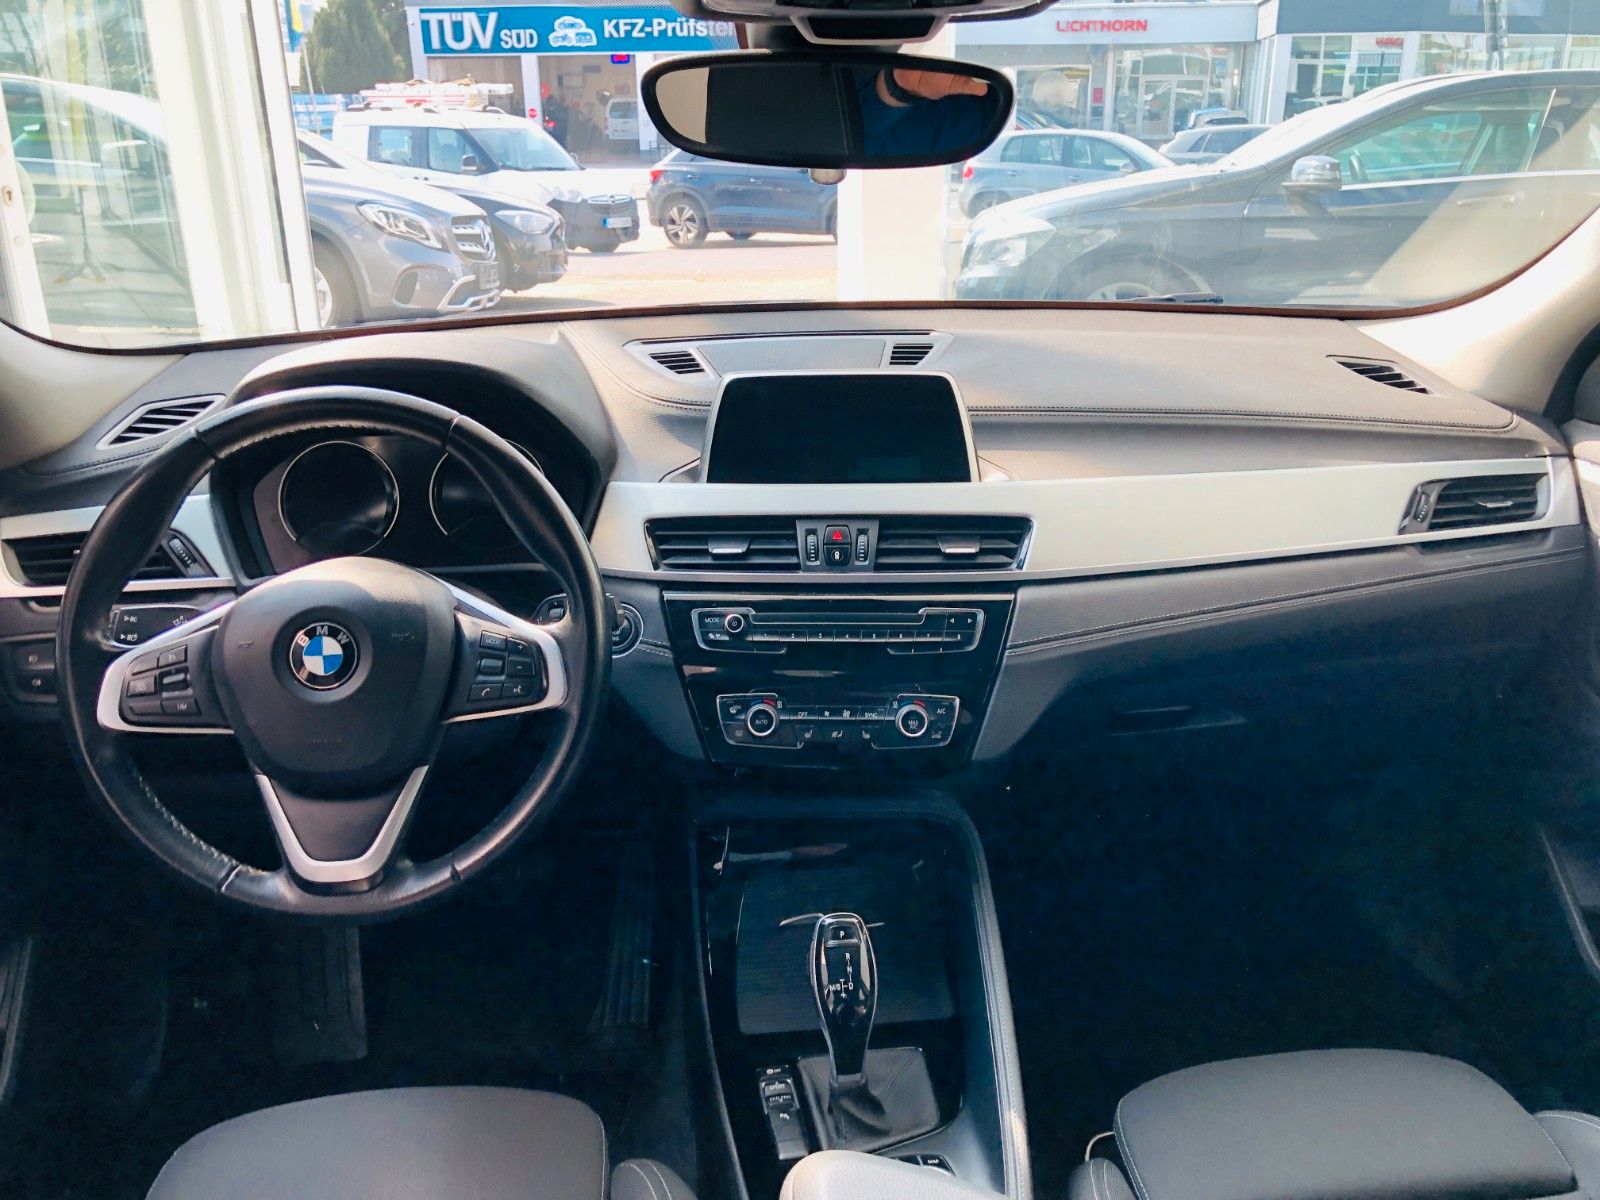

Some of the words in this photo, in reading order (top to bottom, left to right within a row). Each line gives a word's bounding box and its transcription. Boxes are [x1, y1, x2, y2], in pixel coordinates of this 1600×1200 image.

[419, 12, 498, 50] TÜV
[500, 28, 539, 49] SÜD
[1056, 20, 1148, 32] LICHTHORN
[297, 625, 349, 647] BMW
[840, 930, 845, 938] P
[845, 952, 851, 960] R
